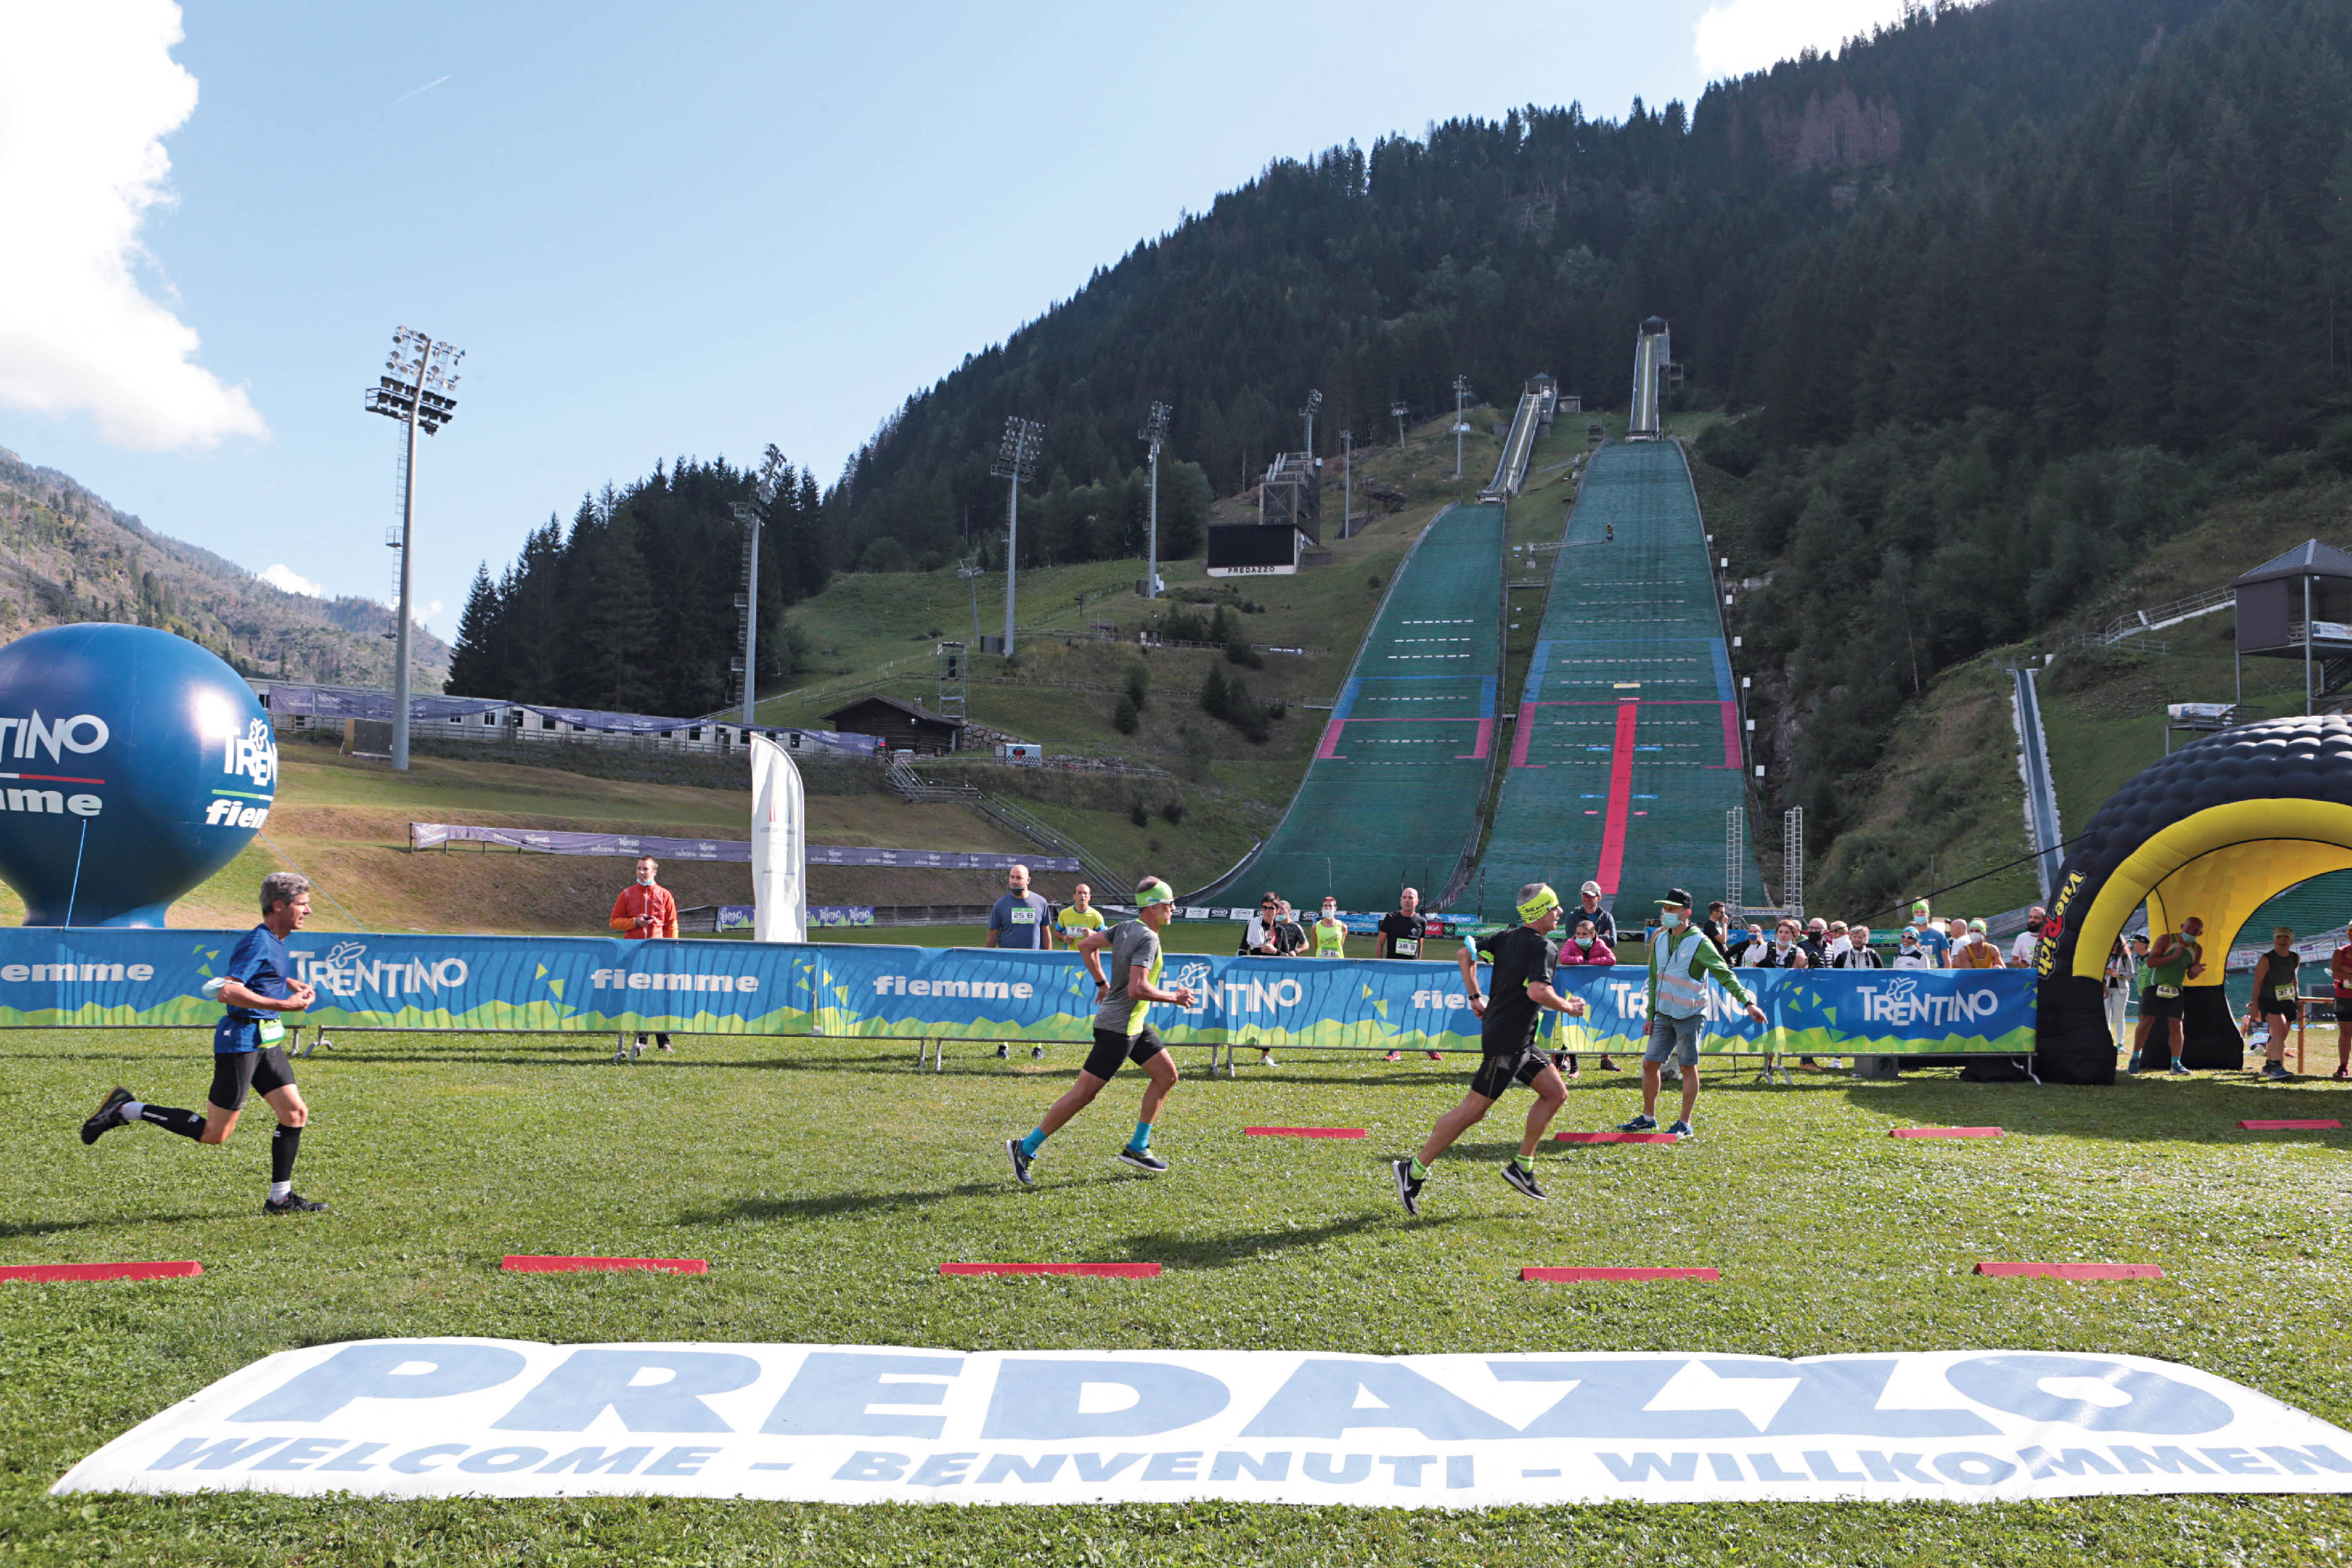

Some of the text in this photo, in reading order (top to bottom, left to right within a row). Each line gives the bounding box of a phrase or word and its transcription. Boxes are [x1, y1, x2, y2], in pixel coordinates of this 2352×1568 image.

[2038, 873, 2085, 976] VueRich
[289, 951, 469, 997] TRENTINO
[591, 969, 759, 992] fiemme
[873, 976, 1033, 998] fiemme
[1856, 986, 1998, 1026] TRENTINO
[226, 1344, 2234, 1440] PREDAZZO
[145, 1437, 724, 1476] WELCOME
[831, 1450, 1474, 1488] BENVENUTI
[1595, 1445, 2352, 1486] WILLKOMMEN
